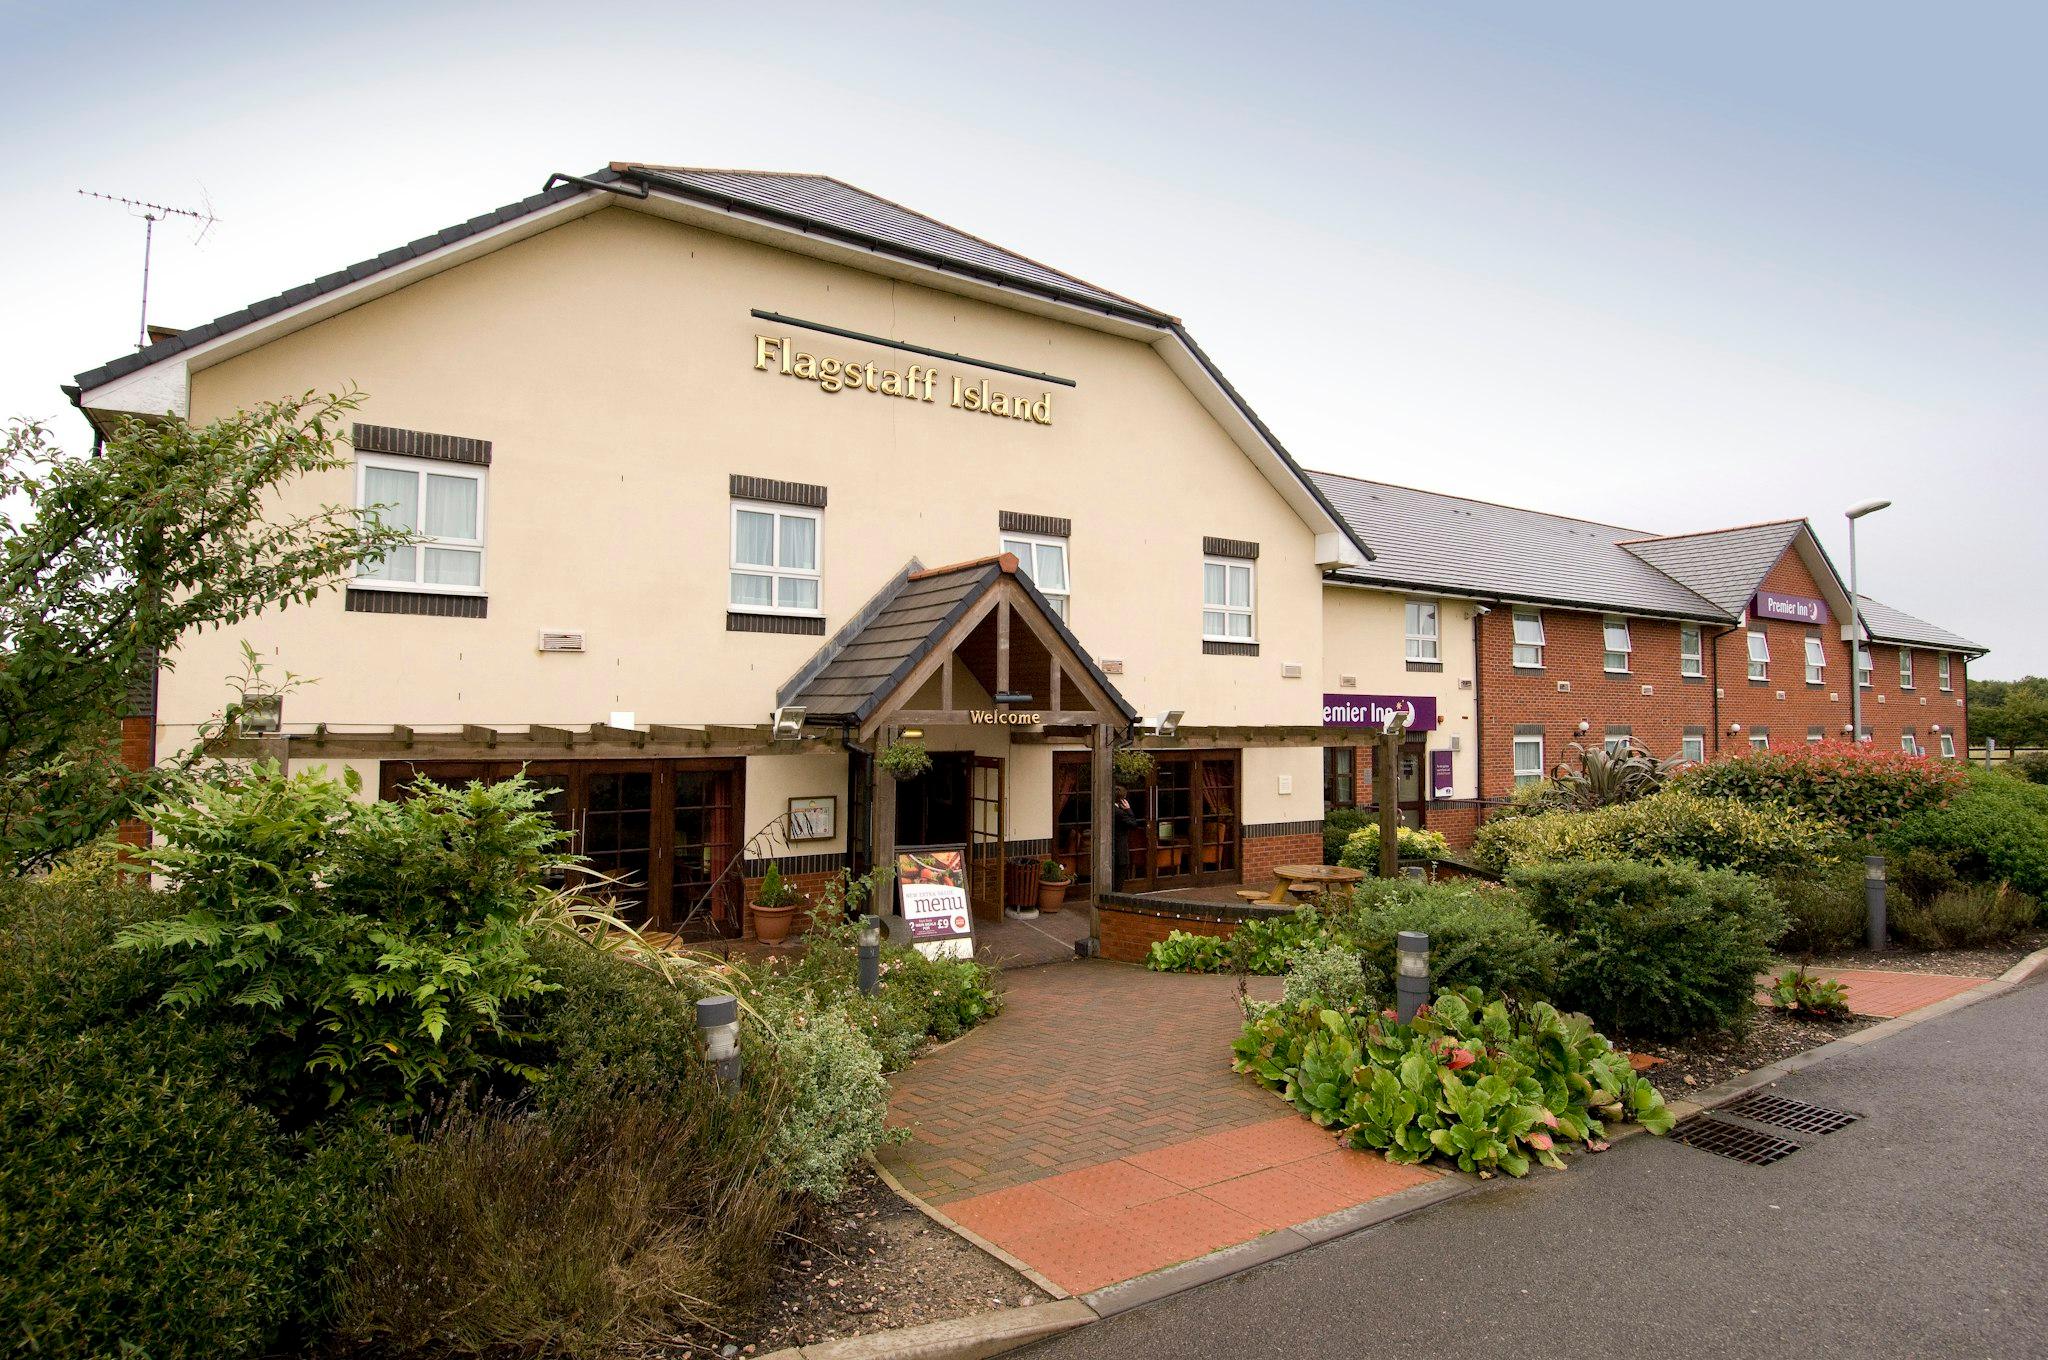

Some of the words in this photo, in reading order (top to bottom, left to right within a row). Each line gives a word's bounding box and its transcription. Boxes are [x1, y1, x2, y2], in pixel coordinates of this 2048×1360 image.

[754, 334, 938, 403] Flagstaff
[951, 375, 1053, 425] Island
[1768, 598, 1796, 614] Premier
[1797, 602, 1808, 616] Inn
[969, 708, 1041, 724] Welcome
[914, 896, 964, 912] menu
[938, 919, 948, 928] £9
